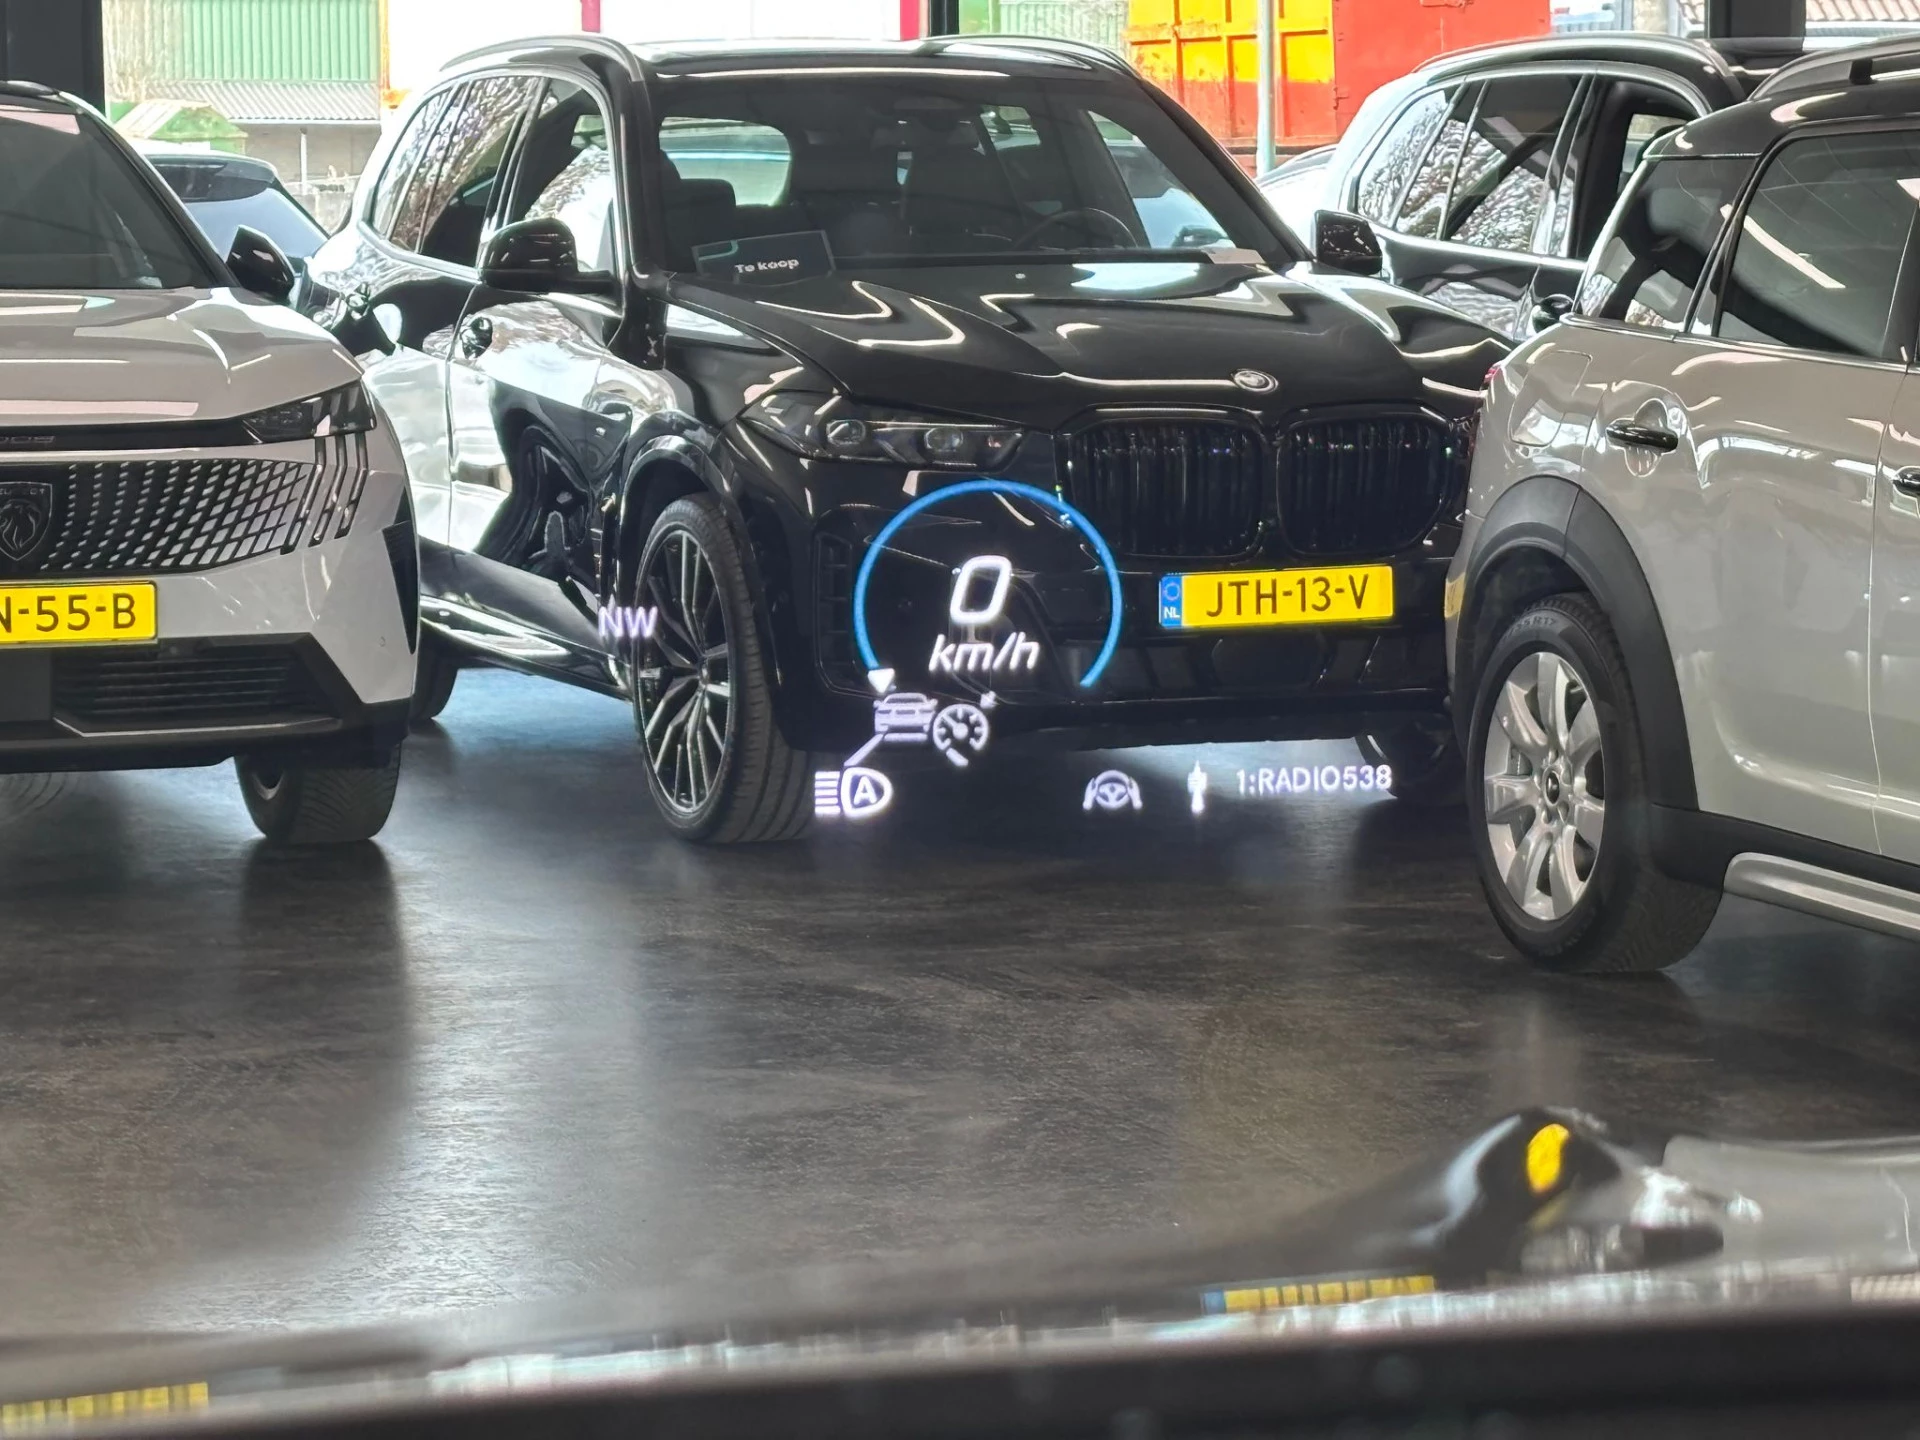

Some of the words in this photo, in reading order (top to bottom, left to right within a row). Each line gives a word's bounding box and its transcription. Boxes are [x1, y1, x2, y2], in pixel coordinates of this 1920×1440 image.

[757, 258, 800, 270] koop
[950, 554, 1012, 625] 0
[1205, 573, 1370, 618] JTH-13-V
[598, 605, 659, 639] NW
[1163, 606, 1181, 619] NL
[928, 631, 1041, 672] km/h
